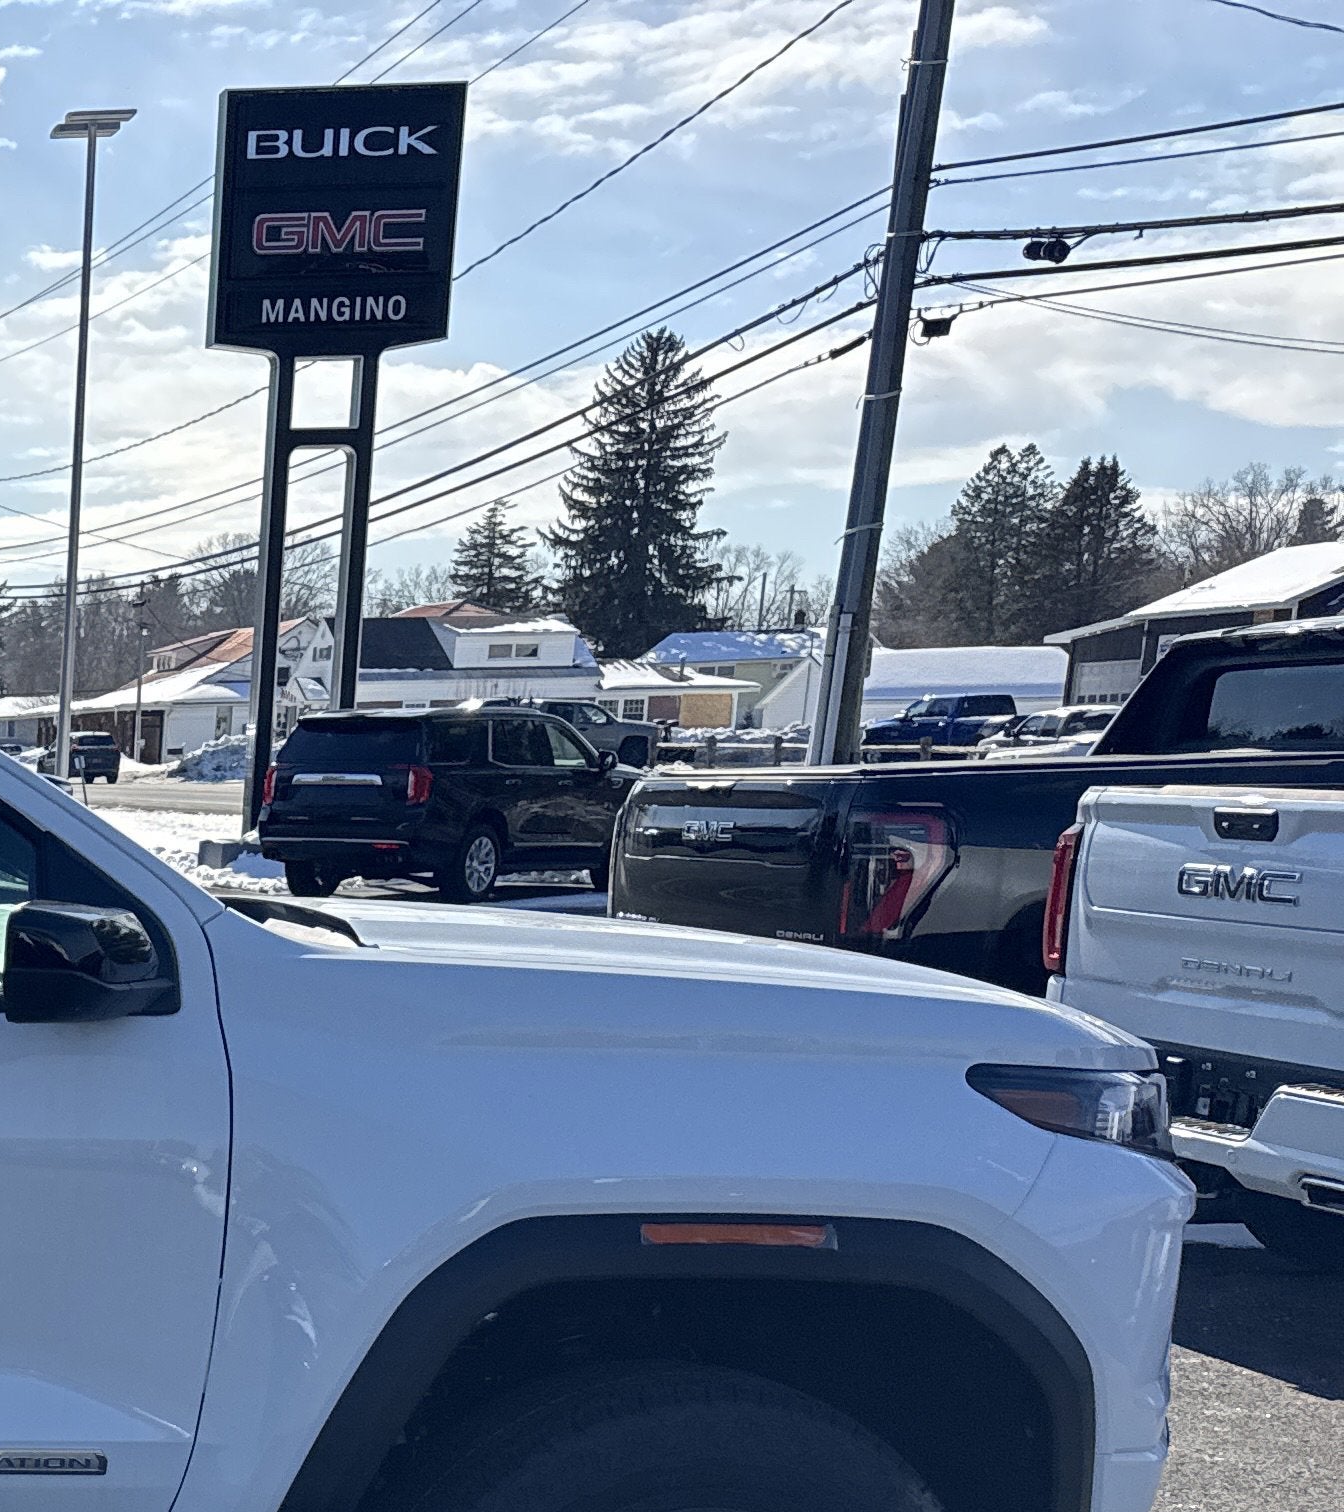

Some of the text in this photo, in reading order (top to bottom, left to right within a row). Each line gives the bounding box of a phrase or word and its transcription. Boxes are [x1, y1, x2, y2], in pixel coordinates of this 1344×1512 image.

[246, 125, 440, 160] BUICK
[252, 208, 427, 255] GMC
[261, 294, 408, 324] MANGINO
[681, 820, 737, 842] GMC
[1176, 862, 1303, 907] GMC
[775, 930, 825, 942] DENALI
[1180, 957, 1293, 983] DENALI
